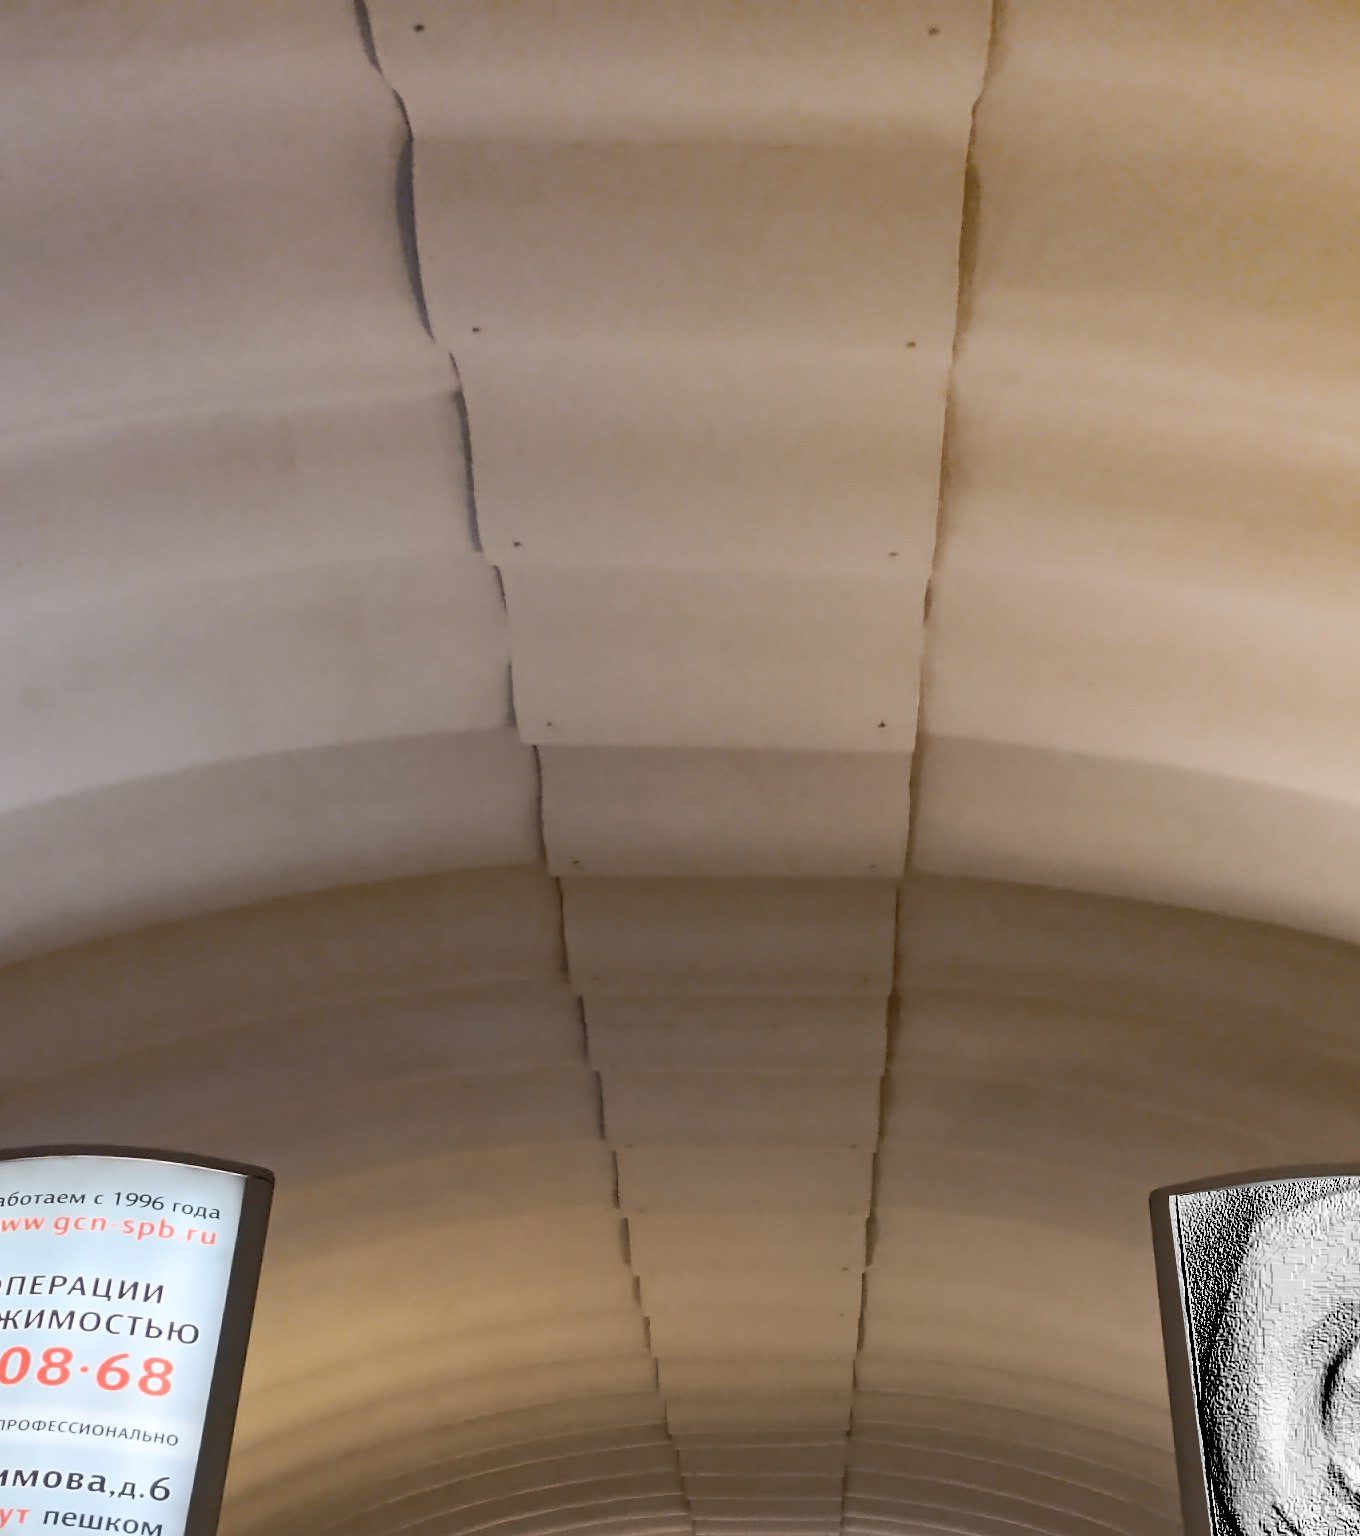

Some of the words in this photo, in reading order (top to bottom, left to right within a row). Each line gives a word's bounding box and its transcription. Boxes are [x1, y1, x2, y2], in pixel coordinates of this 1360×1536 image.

[94, 1193, 104, 1205] с
[115, 1191, 165, 1211] 1996
[172, 1201, 221, 1220] года
